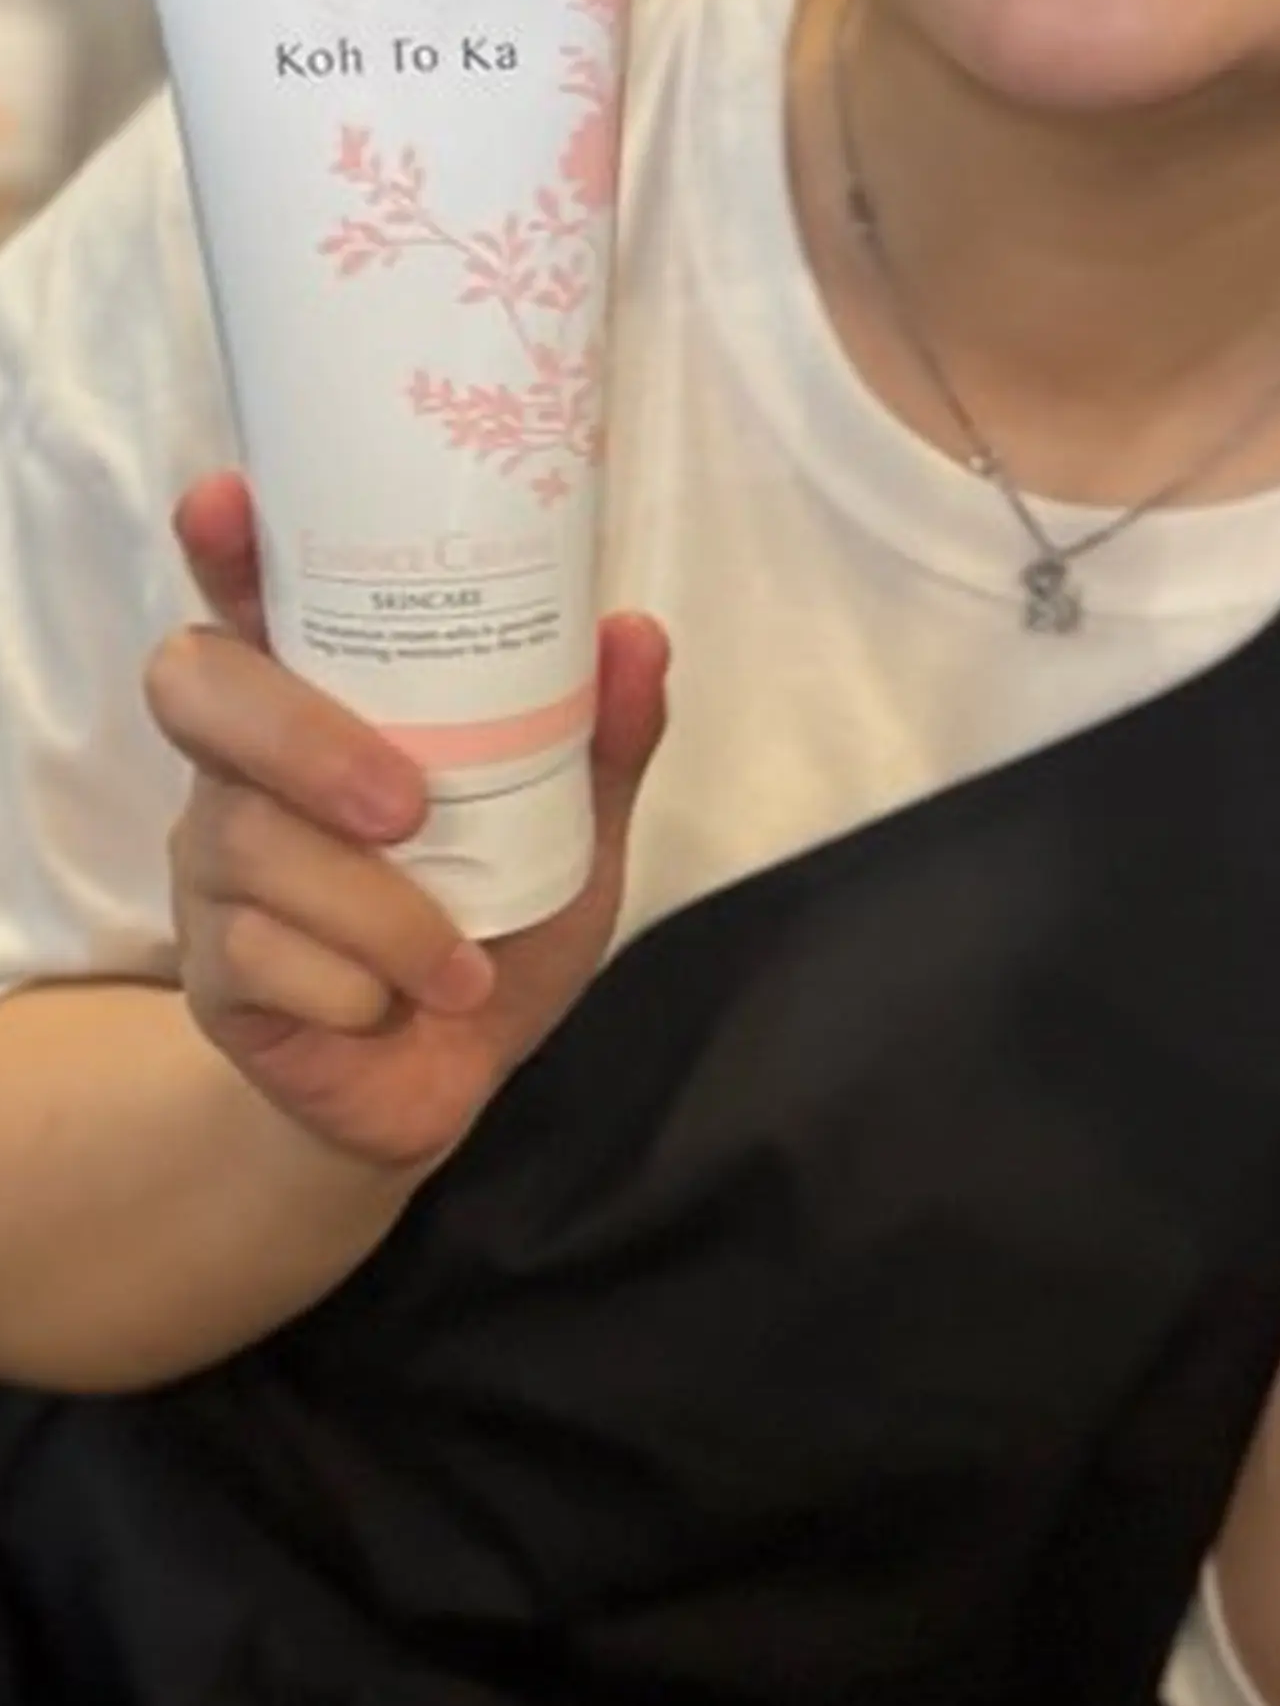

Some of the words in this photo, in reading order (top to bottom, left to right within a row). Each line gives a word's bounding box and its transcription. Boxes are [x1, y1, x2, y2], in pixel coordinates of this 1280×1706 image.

[275, 37, 365, 78] Koh
[390, 37, 440, 75] To
[461, 36, 520, 73] Ka
